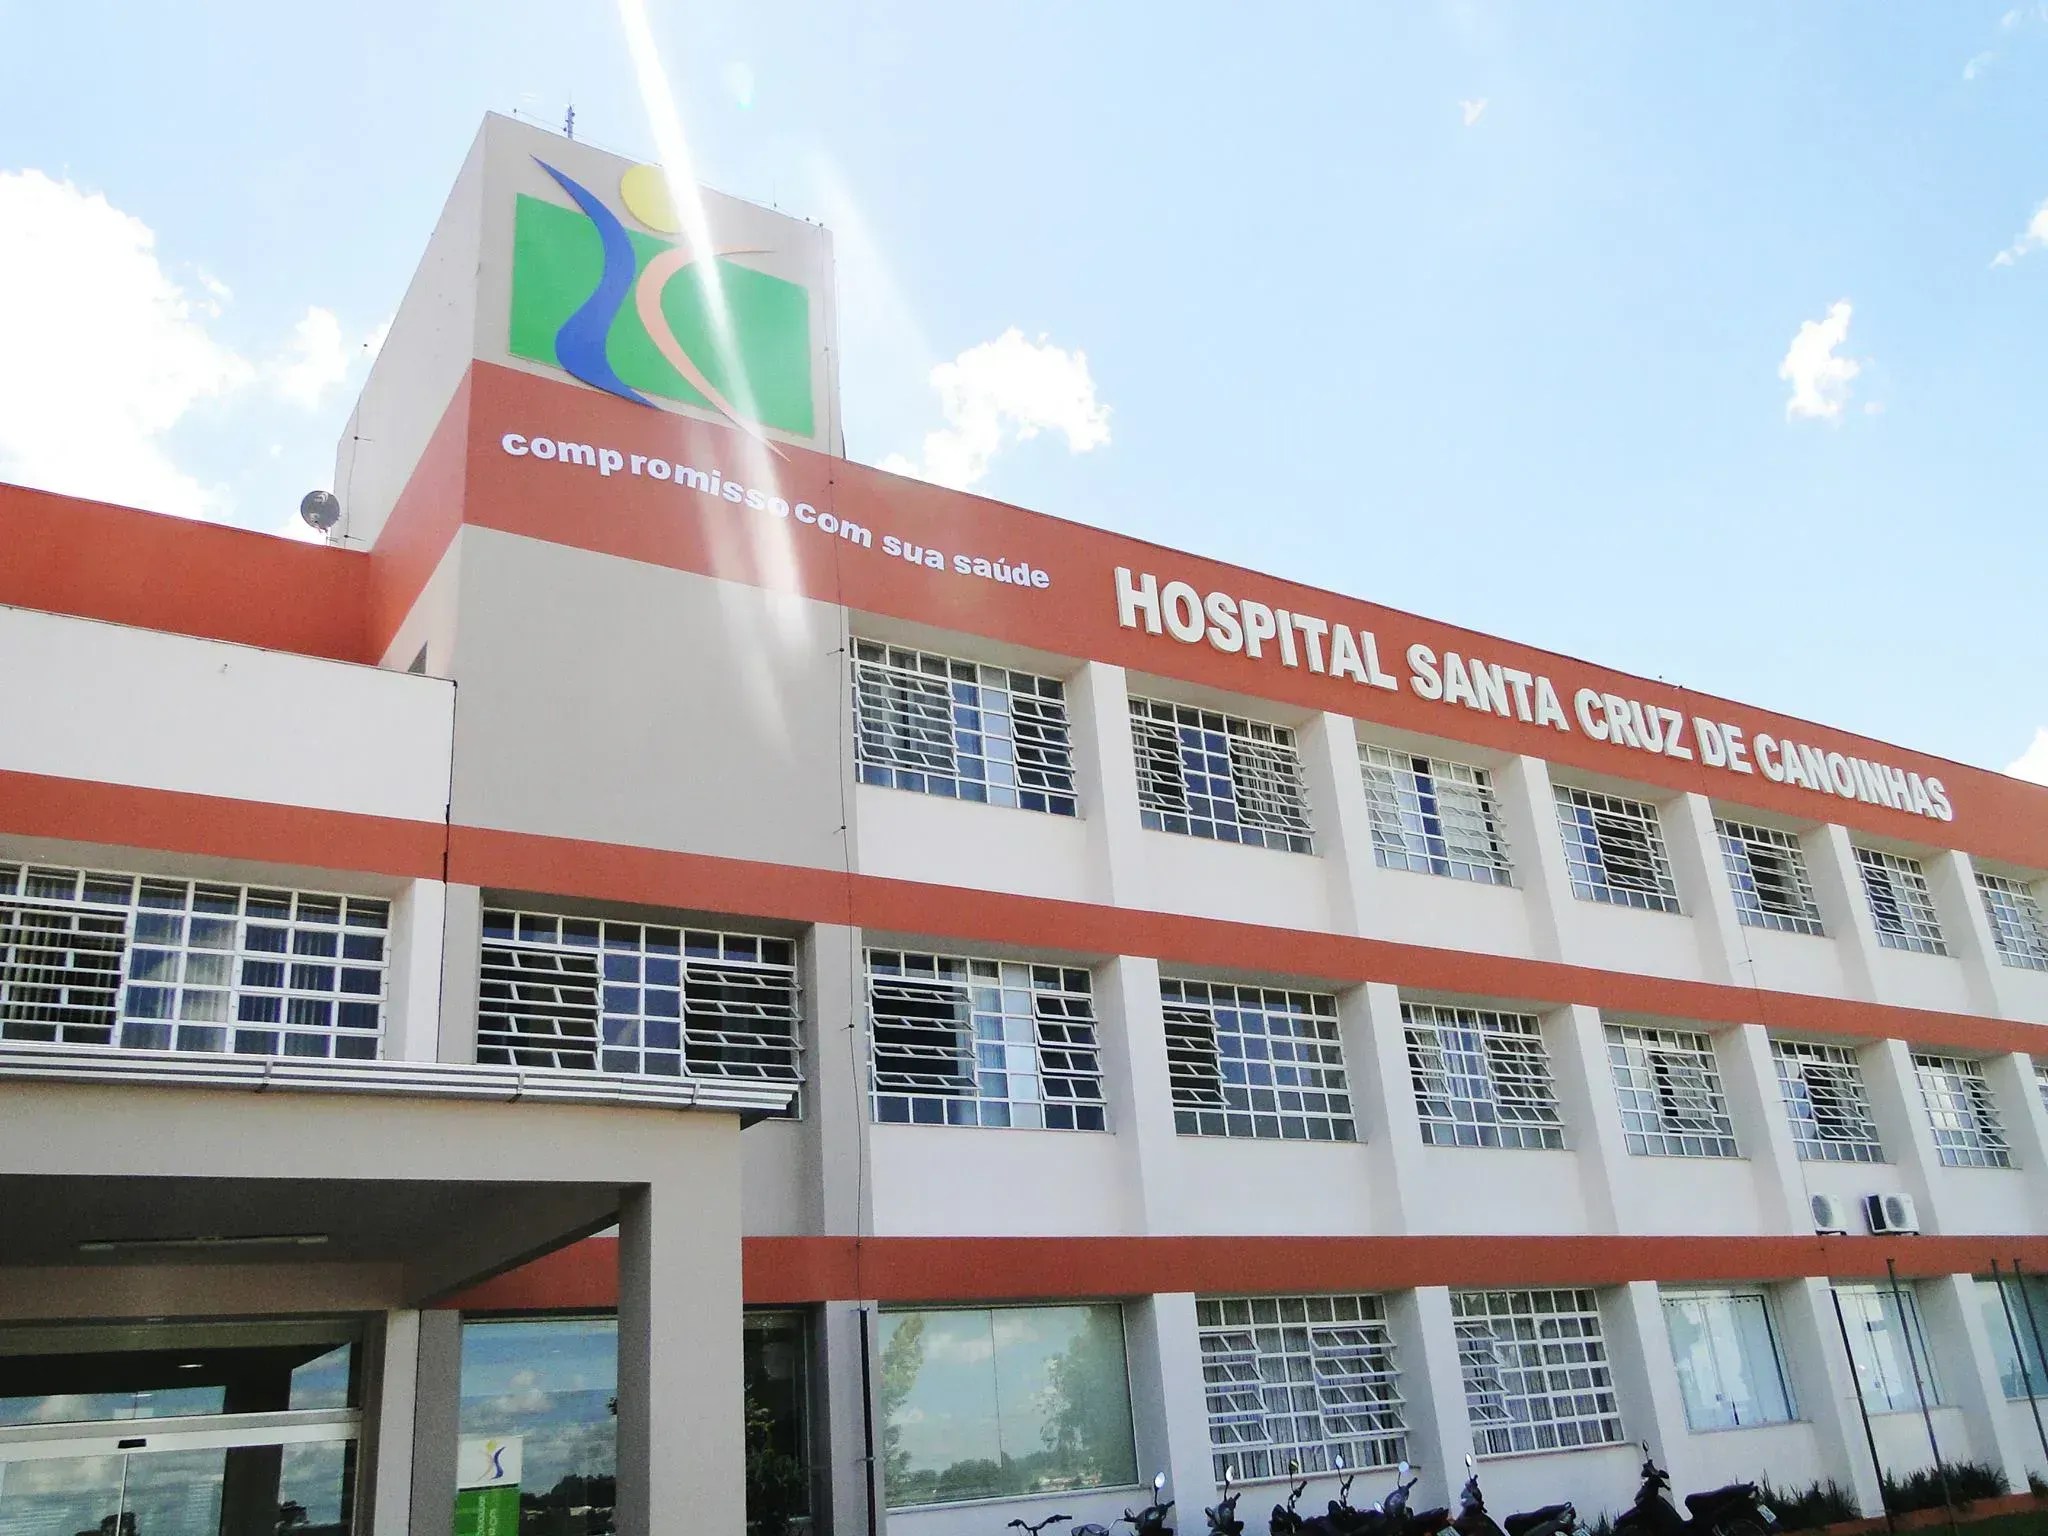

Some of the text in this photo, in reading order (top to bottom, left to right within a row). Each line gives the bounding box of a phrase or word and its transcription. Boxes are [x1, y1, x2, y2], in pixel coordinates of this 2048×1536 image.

[794, 503, 872, 548] com
[882, 533, 945, 570] sua
[953, 555, 1051, 589] saúde
[1114, 566, 1953, 822] HOSPITAL SANTA CRUZ DE CANOINHAS
